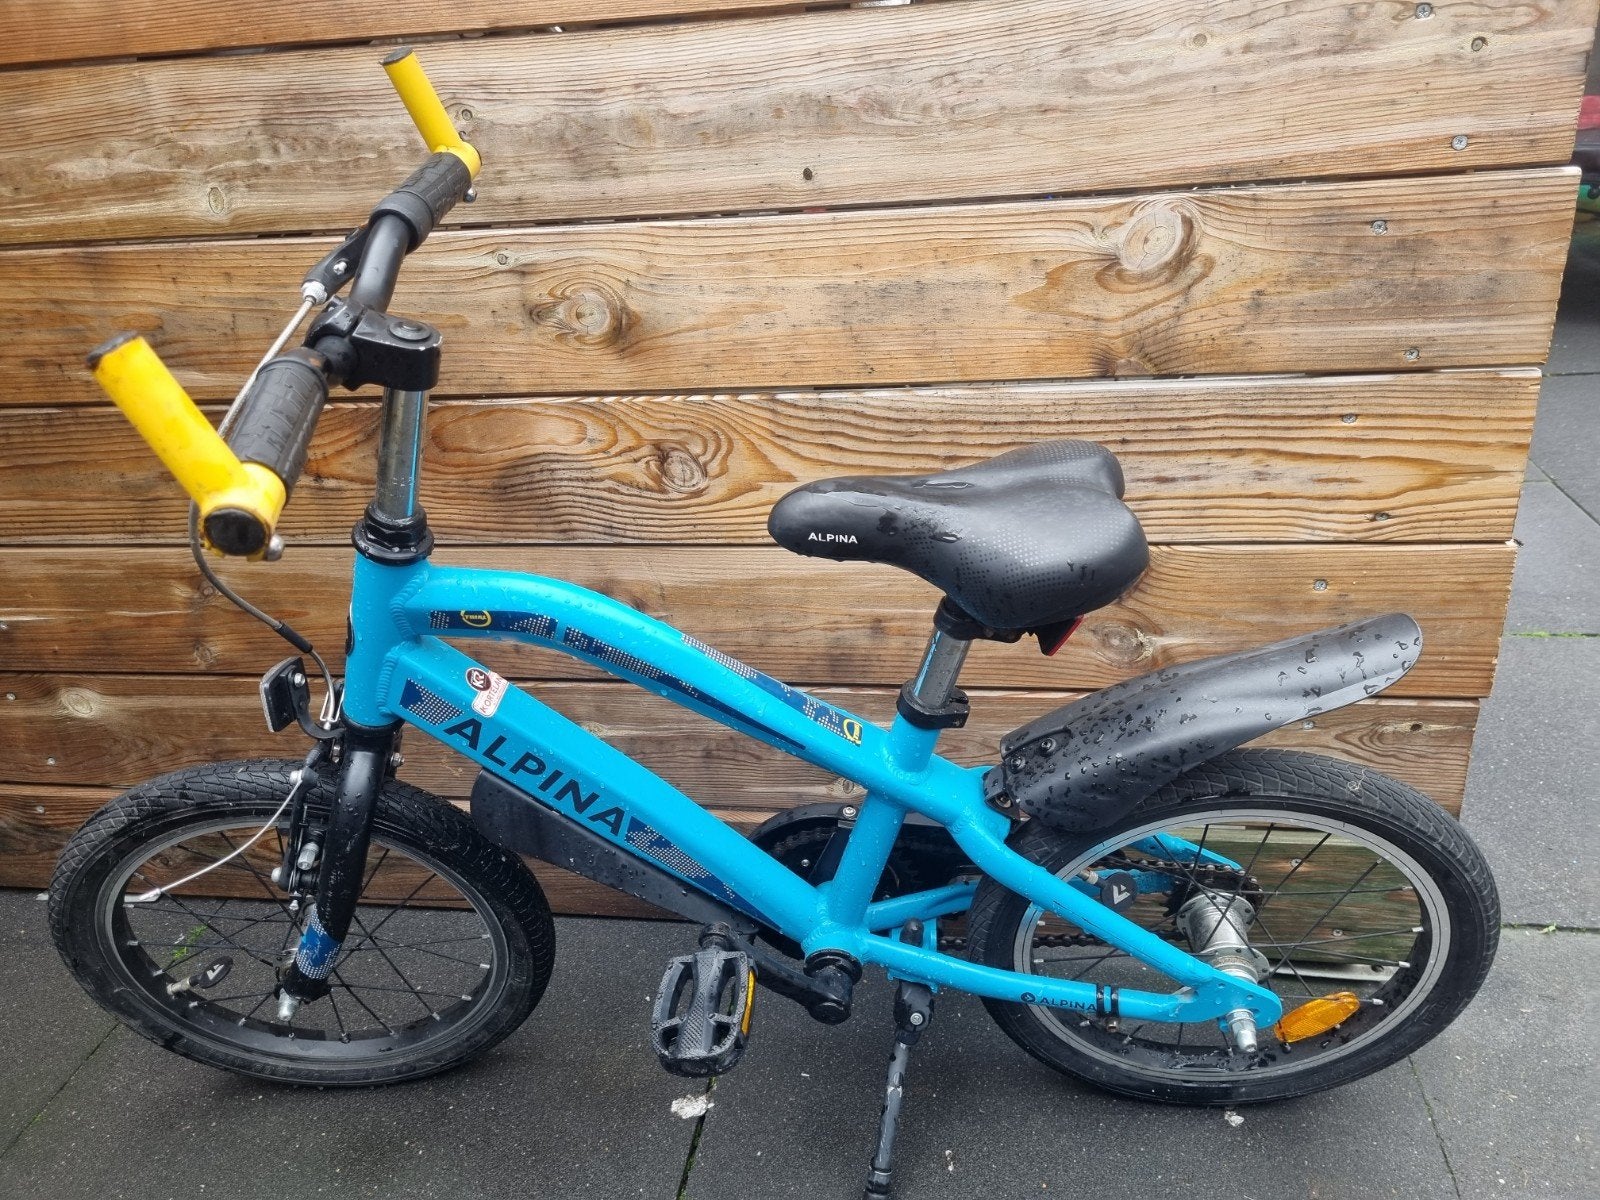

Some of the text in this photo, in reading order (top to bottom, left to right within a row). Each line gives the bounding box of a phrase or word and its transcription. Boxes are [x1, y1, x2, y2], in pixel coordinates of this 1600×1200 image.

[808, 532, 858, 544] ALPINA
[443, 717, 626, 836] ALPINA
[1040, 997, 1096, 1012] ALPINA
